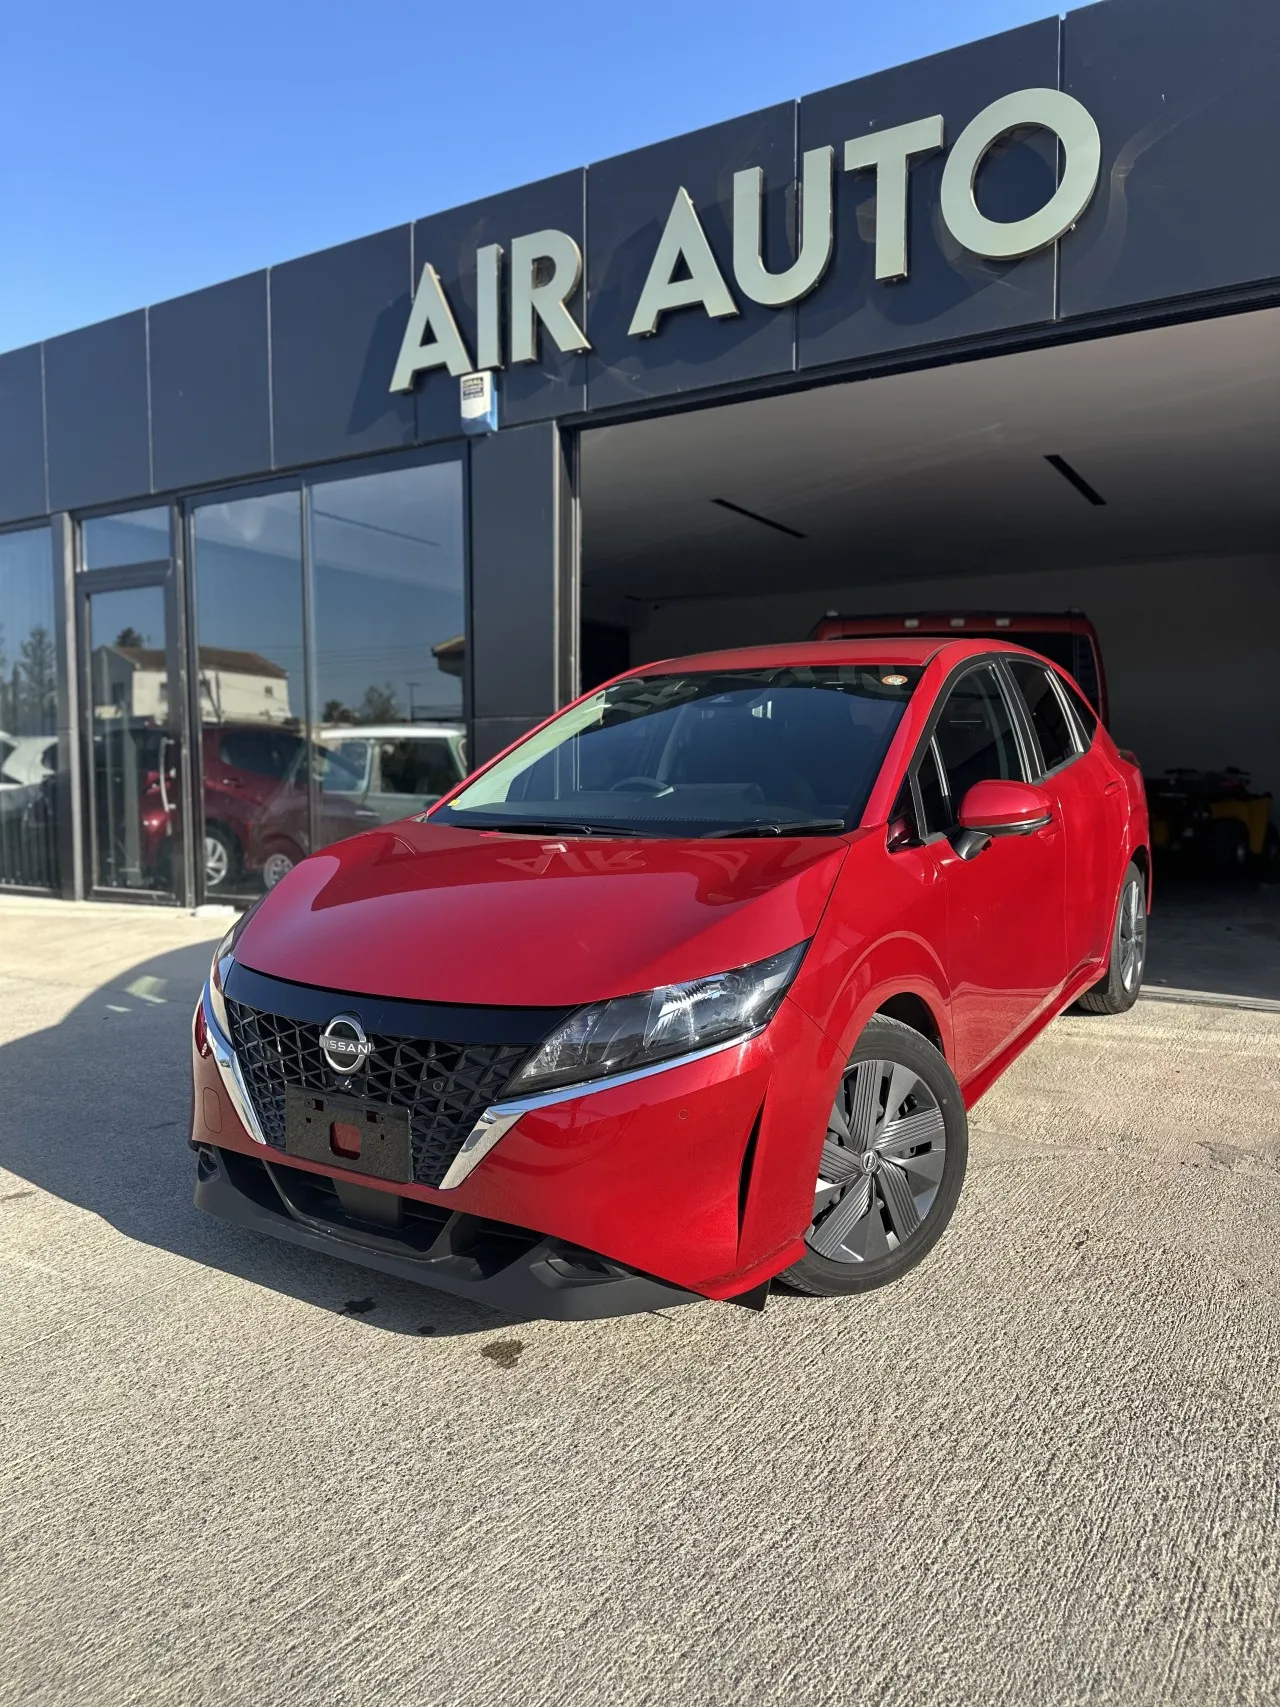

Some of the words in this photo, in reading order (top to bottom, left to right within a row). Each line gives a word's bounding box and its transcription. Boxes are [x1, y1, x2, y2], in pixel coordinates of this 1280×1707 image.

[389, 228, 591, 393] AIR
[627, 87, 1101, 337] AUTO
[320, 1036, 368, 1054] NISSAN
